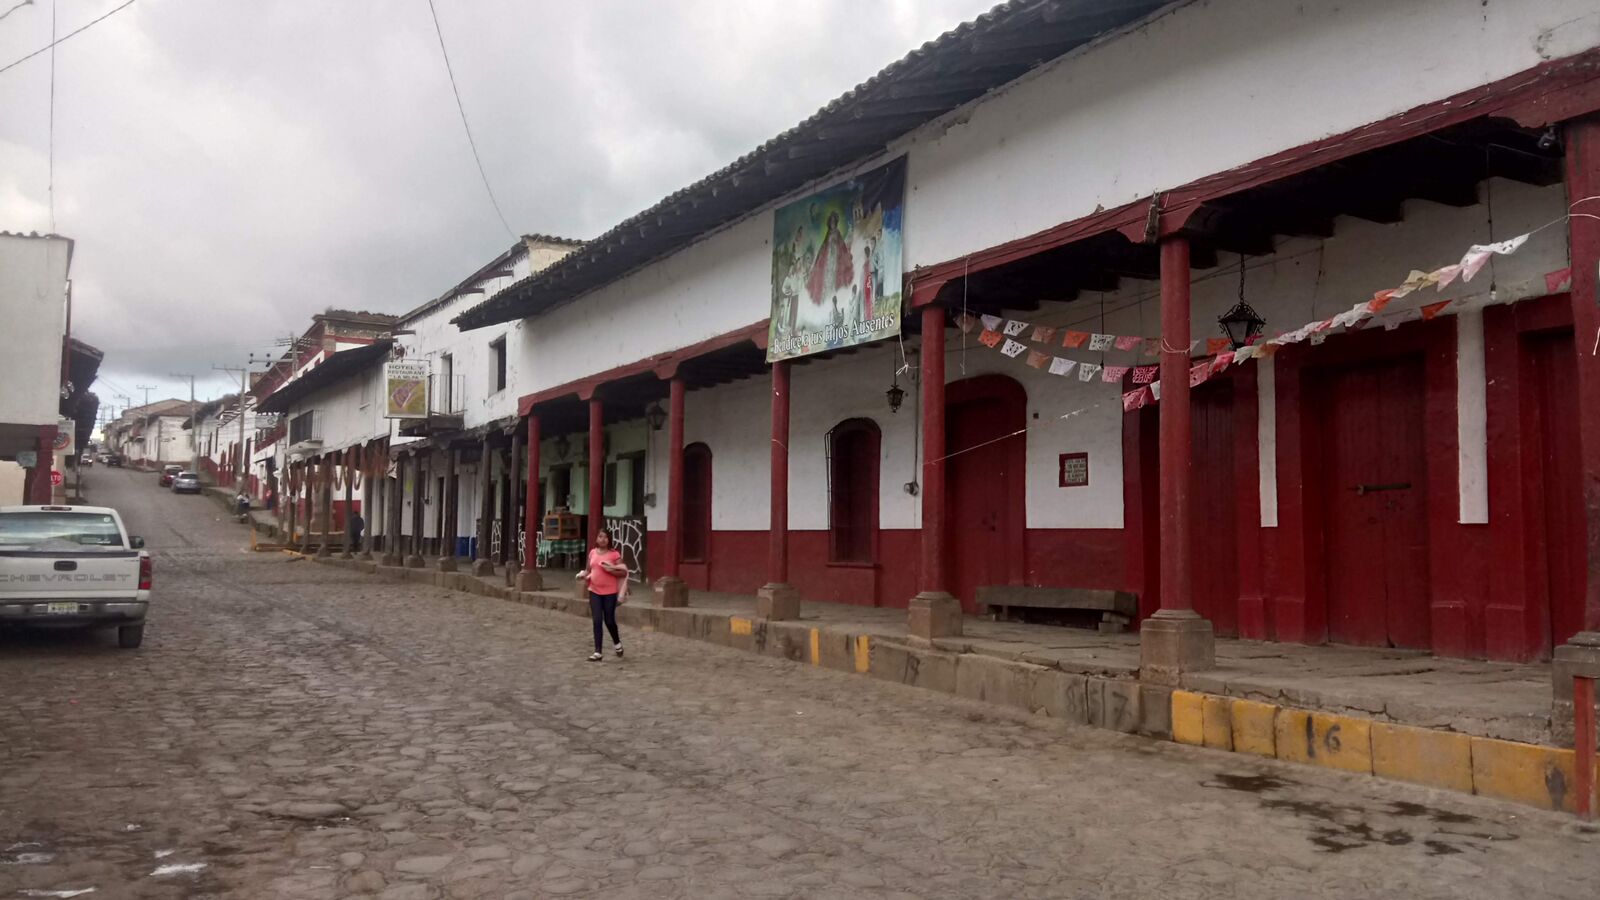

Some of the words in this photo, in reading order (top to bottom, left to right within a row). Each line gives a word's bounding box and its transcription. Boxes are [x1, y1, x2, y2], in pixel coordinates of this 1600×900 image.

[825, 323, 848, 344] Hijos
[851, 312, 894, 336] Ausentes
[1306, 714, 1341, 758] 16
